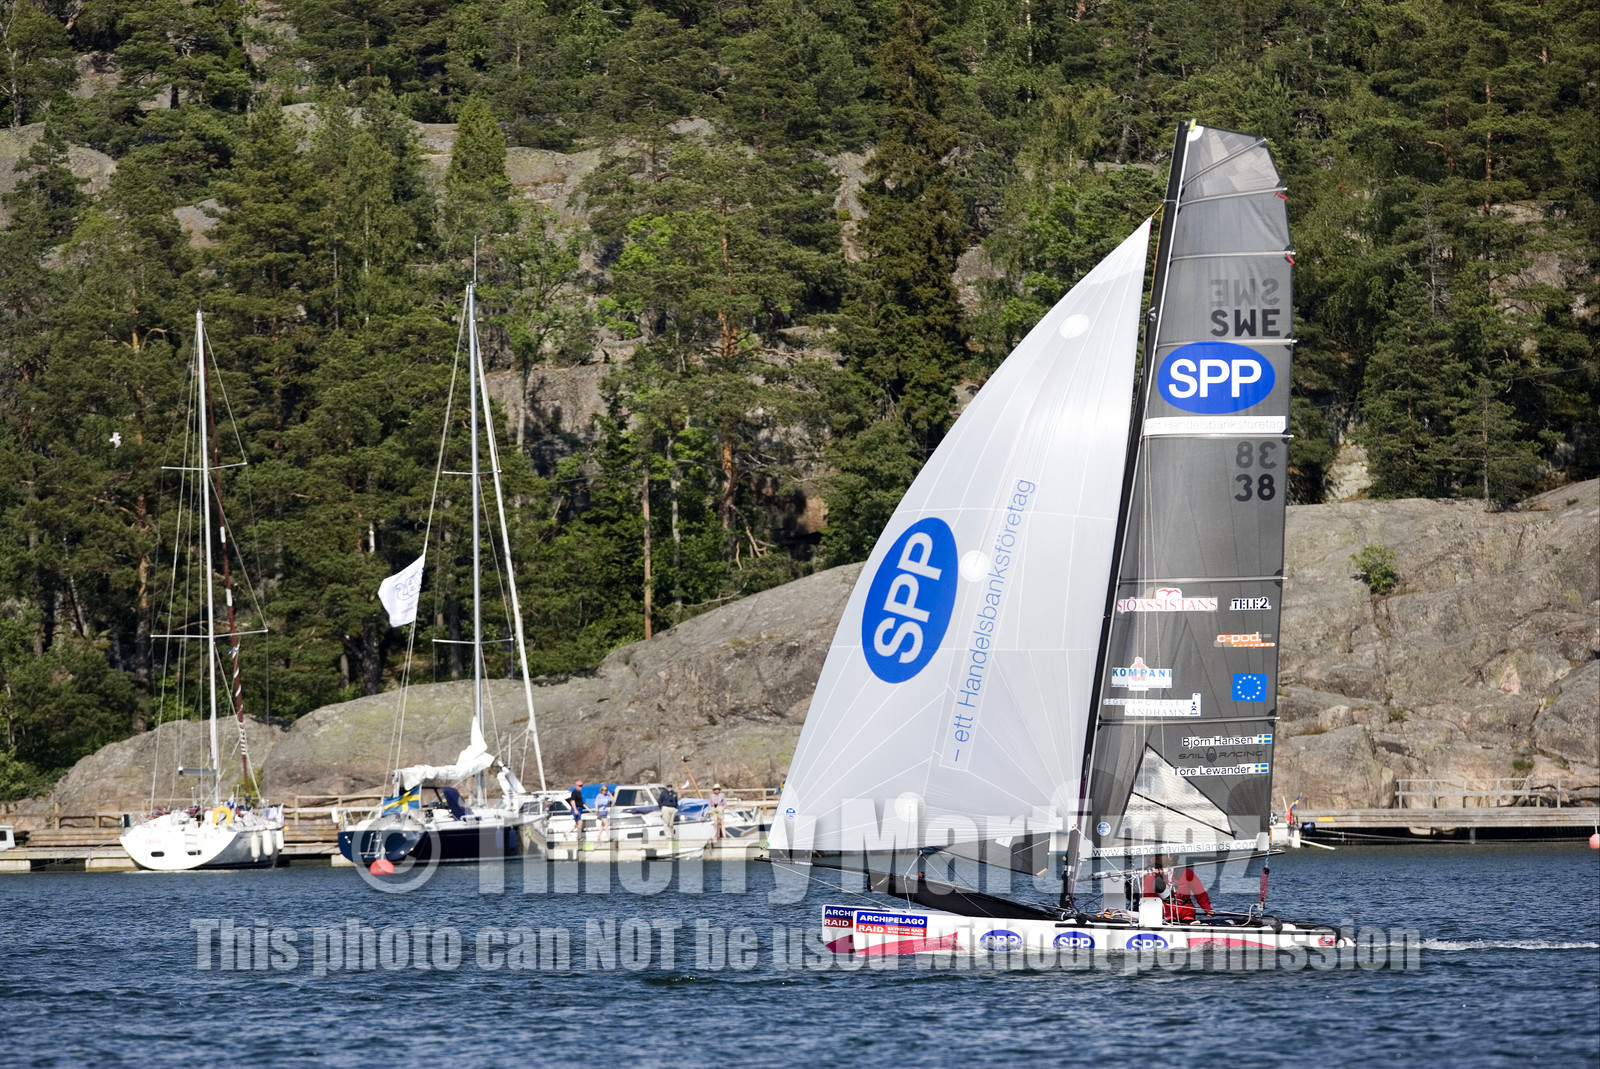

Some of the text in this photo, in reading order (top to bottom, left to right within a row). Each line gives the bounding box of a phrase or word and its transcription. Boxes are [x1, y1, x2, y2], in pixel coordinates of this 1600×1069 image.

[1210, 309, 1280, 337] SWE
[1168, 358, 1262, 399] SPP
[1234, 473, 1275, 502] 38
[873, 532, 942, 664] SPP
[957, 478, 1036, 708] Handelsbanksföretag
[1232, 597, 1268, 610] TELE2
[1112, 668, 1172, 678] KOMPANI
[954, 714, 973, 742] ett
[1213, 736, 1254, 745] Hansen
[1218, 750, 1263, 758] RACING
[1173, 765, 1251, 776] Tore Lewander
[825, 909, 853, 917] ARCHI
[824, 918, 849, 927] RAID
[859, 914, 924, 926] ARCHIPELAGO
[858, 924, 884, 933] RAID
[1058, 936, 1092, 948] SPP
[1131, 938, 1165, 949] SPP
